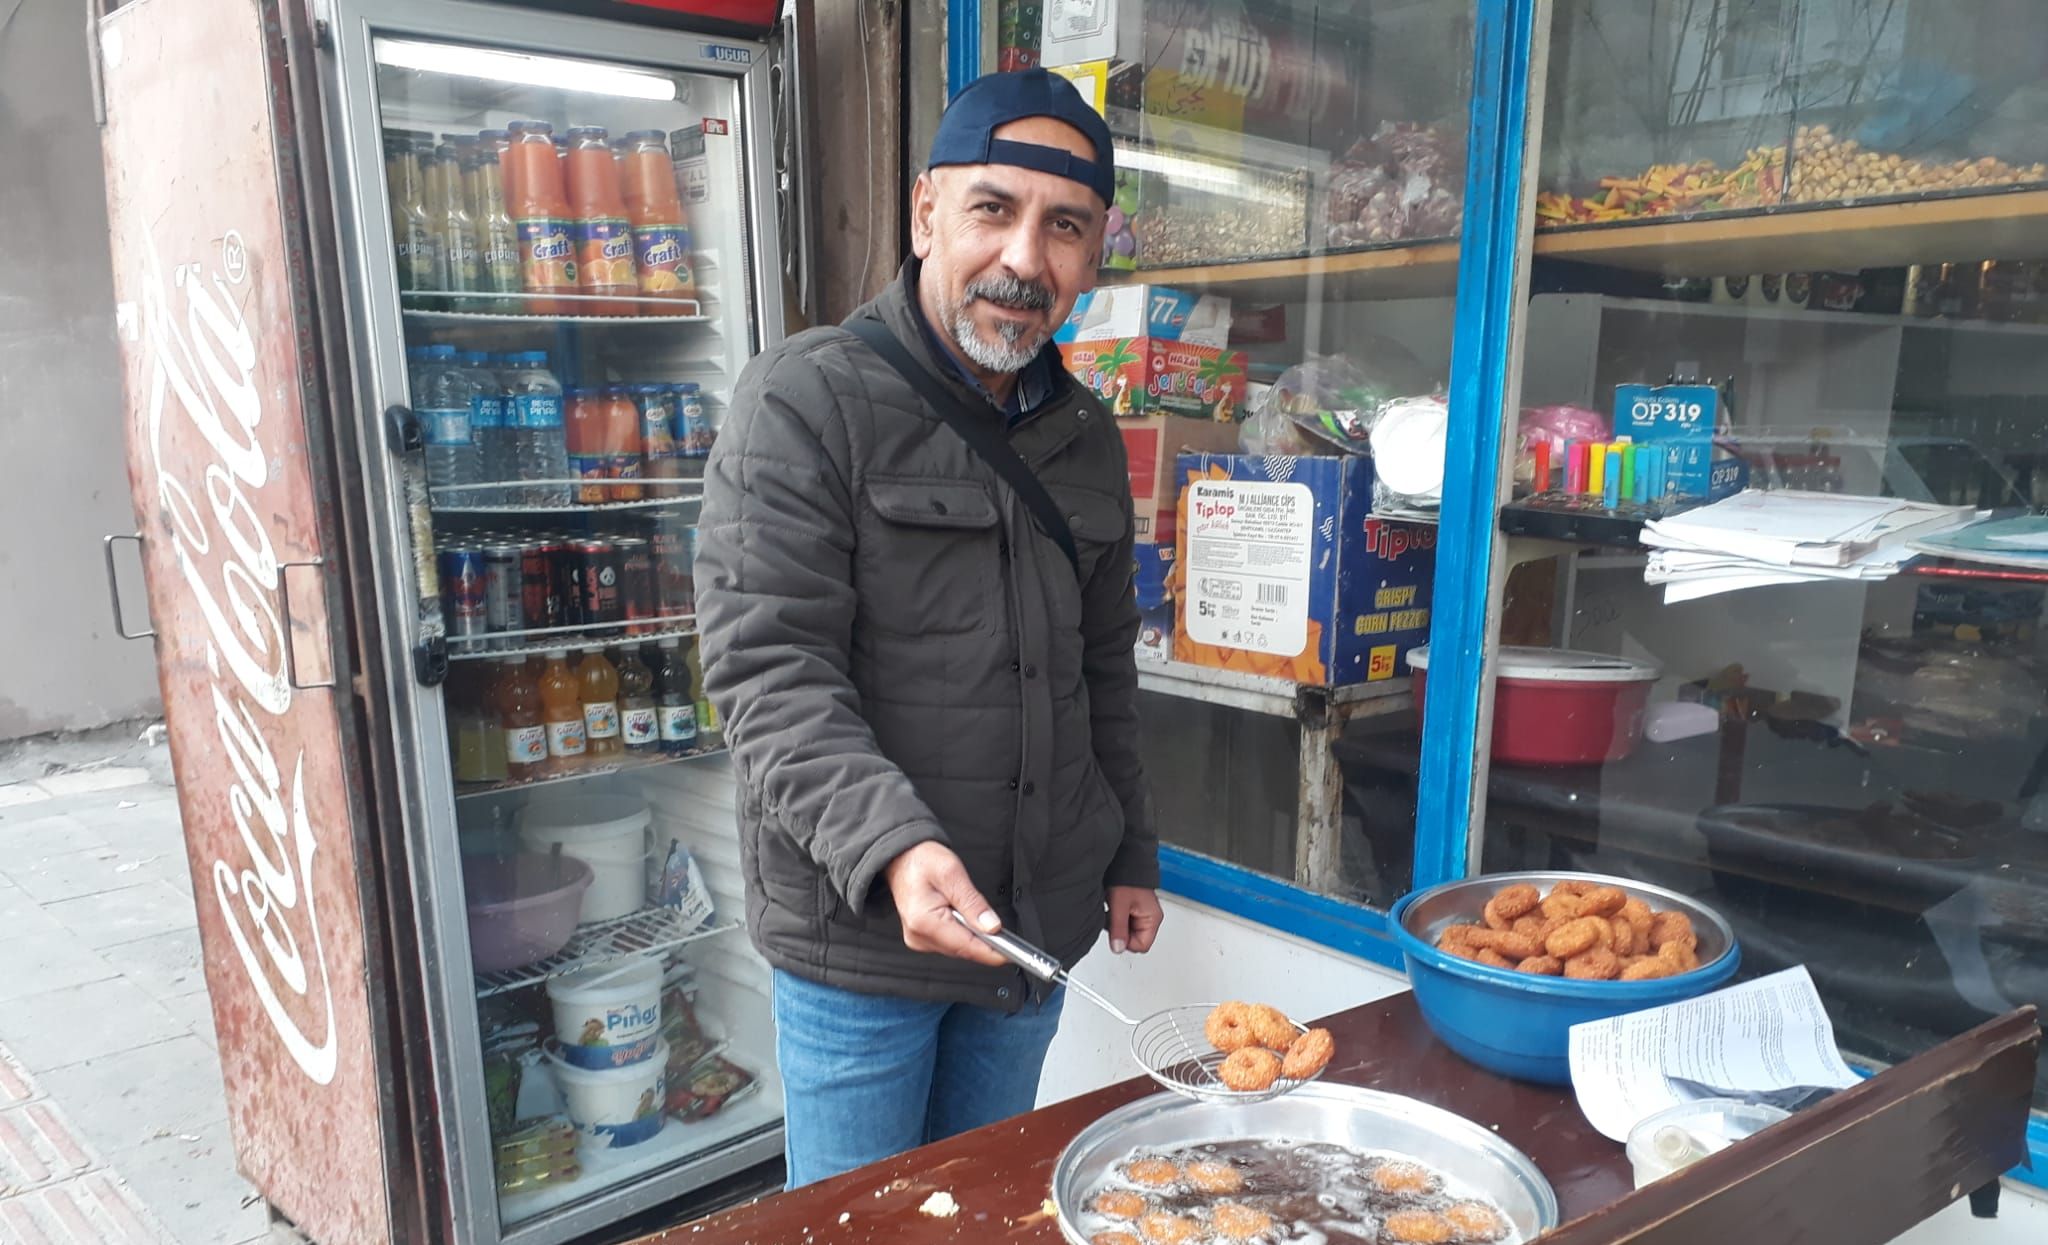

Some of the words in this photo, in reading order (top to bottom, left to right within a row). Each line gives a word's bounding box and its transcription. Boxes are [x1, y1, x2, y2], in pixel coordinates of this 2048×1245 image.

[533, 240, 571, 259] Craft
[644, 245, 682, 267] Craft
[1151, 296, 1178, 324] 77
[1170, 354, 1200, 367] HAZAL
[1631, 402, 1662, 421] OP
[1664, 404, 1701, 421] 319
[1711, 469, 1724, 486] OP
[1724, 466, 1740, 483] 319
[1195, 501, 1235, 519] Tiptop
[1364, 519, 1437, 561] Tipto
[1375, 585, 1417, 608] CRISPY
[1199, 600, 1208, 616] 5
[1355, 612, 1388, 635] CORN
[140, 215, 338, 1086] Coca-Cola
[1371, 656, 1381, 672] 5
